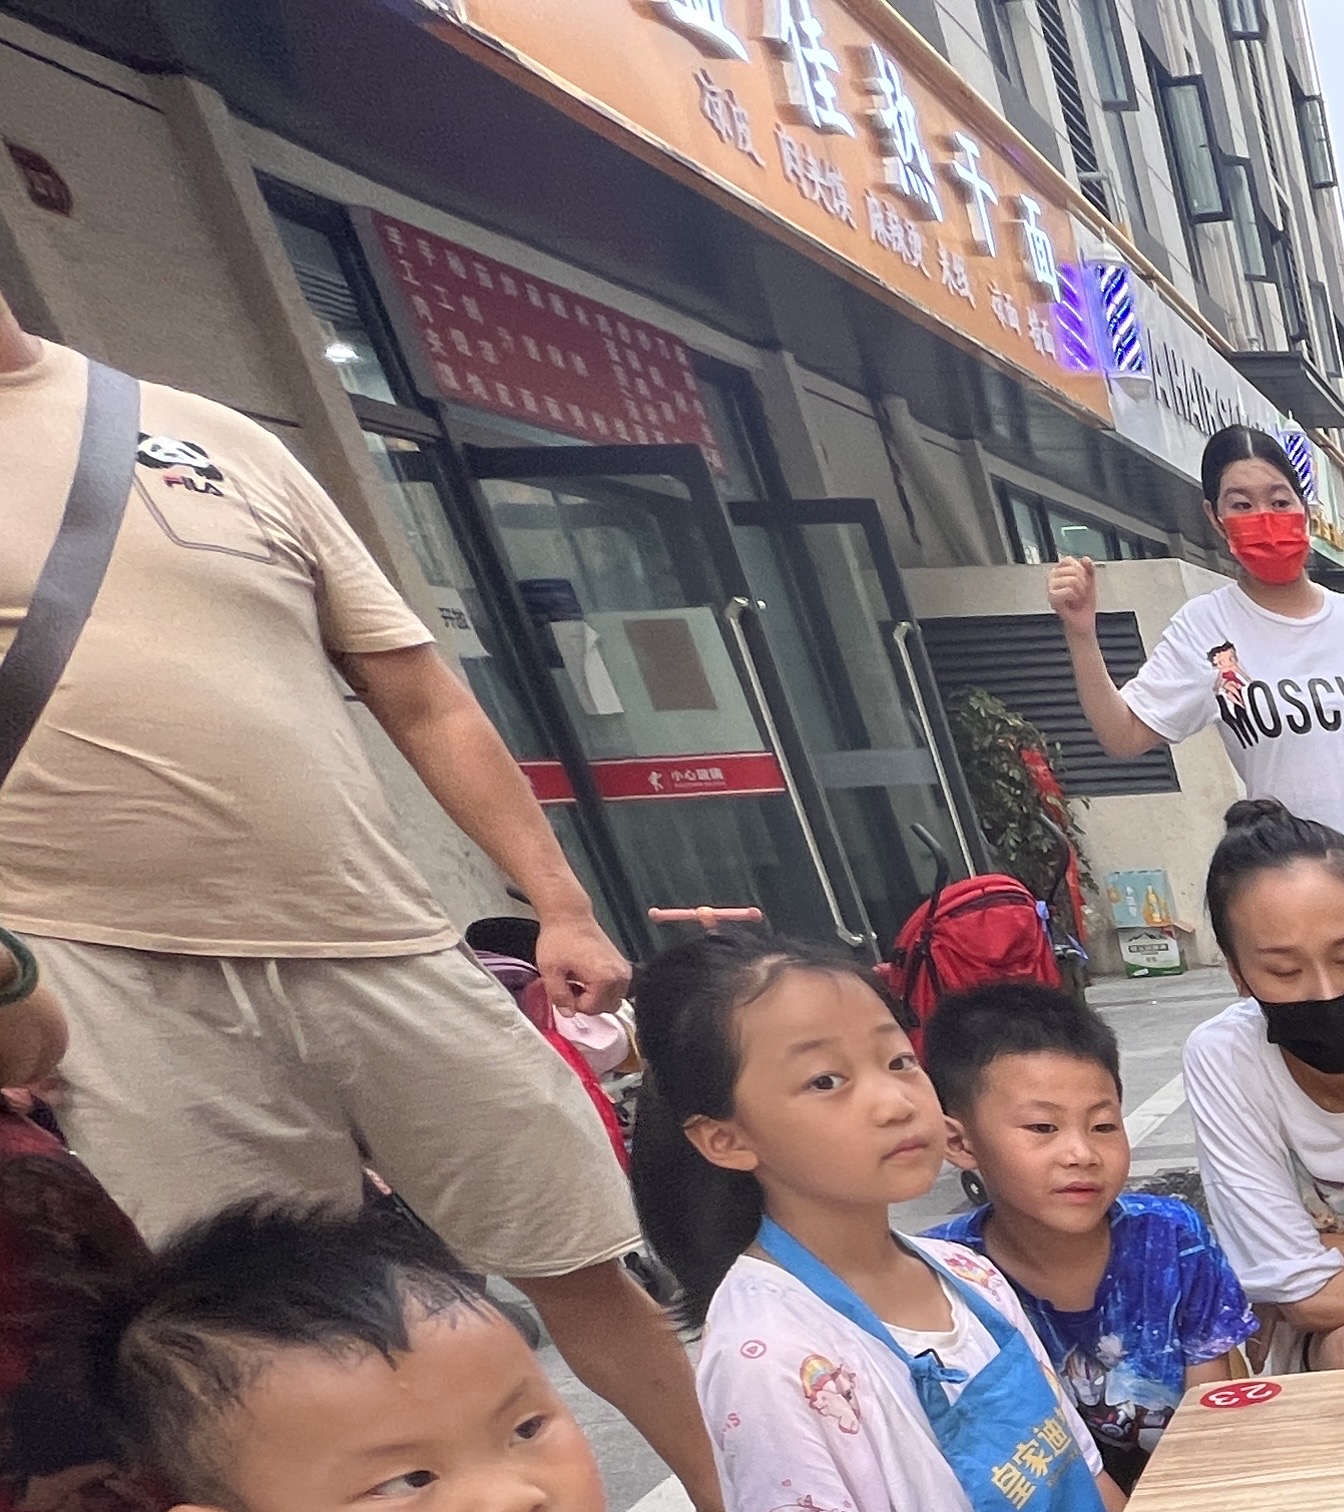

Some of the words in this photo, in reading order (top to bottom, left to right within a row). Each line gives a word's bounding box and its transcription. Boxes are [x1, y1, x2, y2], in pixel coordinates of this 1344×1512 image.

[660, 0, 1061, 304] 佳热干面
[1208, 1383, 1273, 1406] 23
[990, 1405, 1074, 1512] 皇家迪
